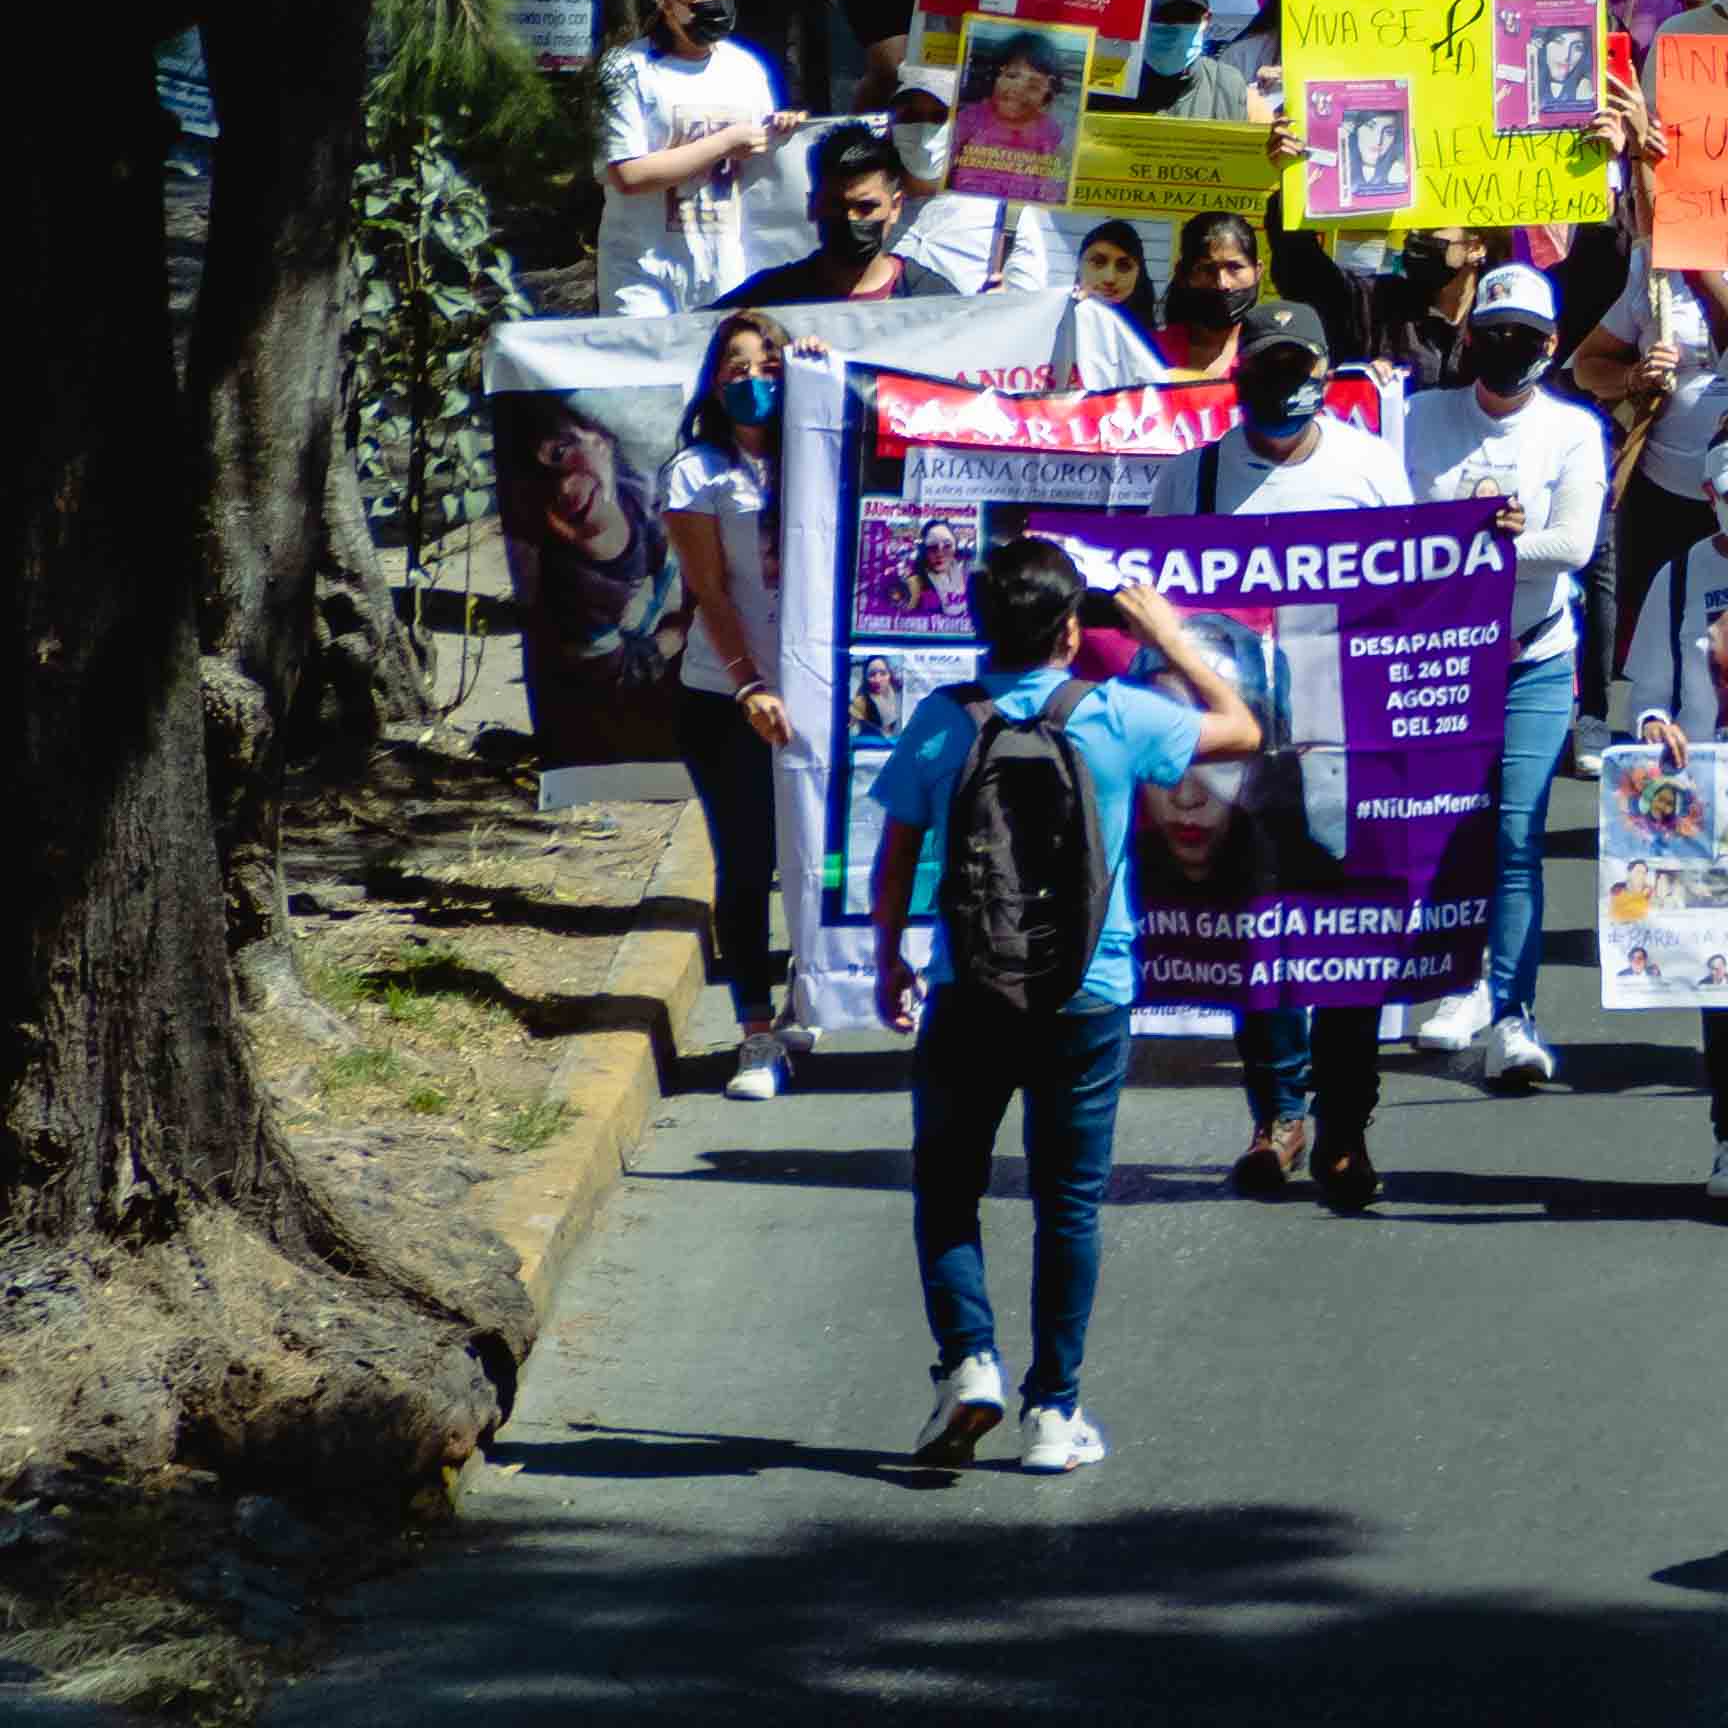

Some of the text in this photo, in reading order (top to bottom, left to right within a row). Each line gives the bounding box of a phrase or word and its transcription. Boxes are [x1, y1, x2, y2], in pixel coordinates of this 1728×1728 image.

[1288, 3, 1359, 49] VIVA
[1129, 163, 1154, 180] SE
[1163, 189, 1196, 206] PAZ
[1424, 172, 1507, 210] VIVA
[910, 457, 1138, 485] ARIANA CORONA
[1075, 528, 1504, 598] SAPARECIDA
[1349, 624, 1500, 658] DESAPARECIÓ
[1388, 656, 1471, 683] EL 26 DE
[1386, 683, 1471, 711] AGOSTO
[1391, 716, 1469, 738] DEL 2016
[1355, 792, 1491, 820] #NiUnaMenos
[1197, 896, 1490, 940] GARCÍA HERNÁNDEZ
[1250, 952, 1453, 986] A ENCONTRARLA
